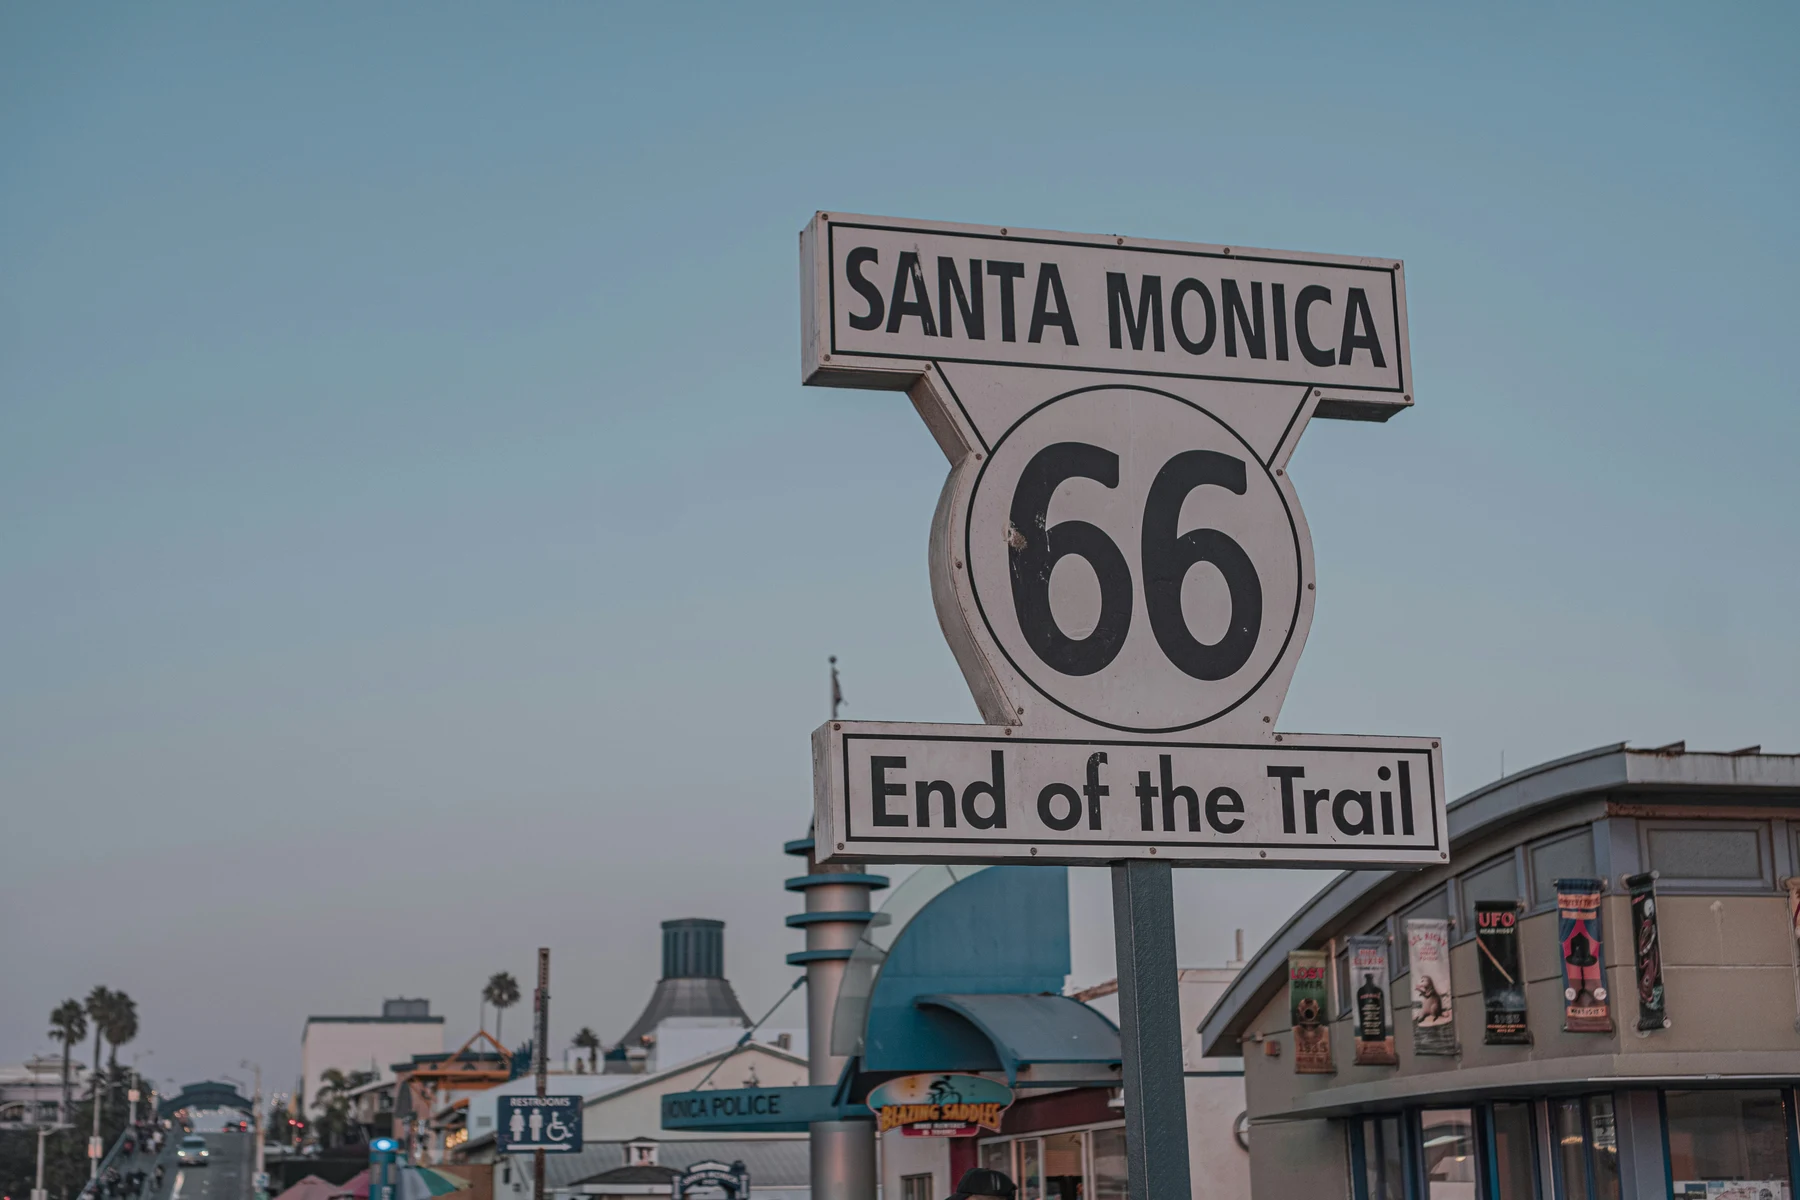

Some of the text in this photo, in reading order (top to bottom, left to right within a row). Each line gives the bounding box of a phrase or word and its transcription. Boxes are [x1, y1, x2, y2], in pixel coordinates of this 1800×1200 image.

[845, 246, 1388, 368] SANTA MONICA
[1008, 441, 1263, 681] 66
[870, 749, 1416, 837] End of the Trail
[1478, 911, 1515, 927] UFO
[1291, 967, 1325, 980] LOST
[1294, 980, 1323, 989] DIVER
[509, 1097, 571, 1107] RESTROOMS
[712, 1094, 781, 1117] POLICE
[880, 1102, 1000, 1132] BLAZING SADDLES
